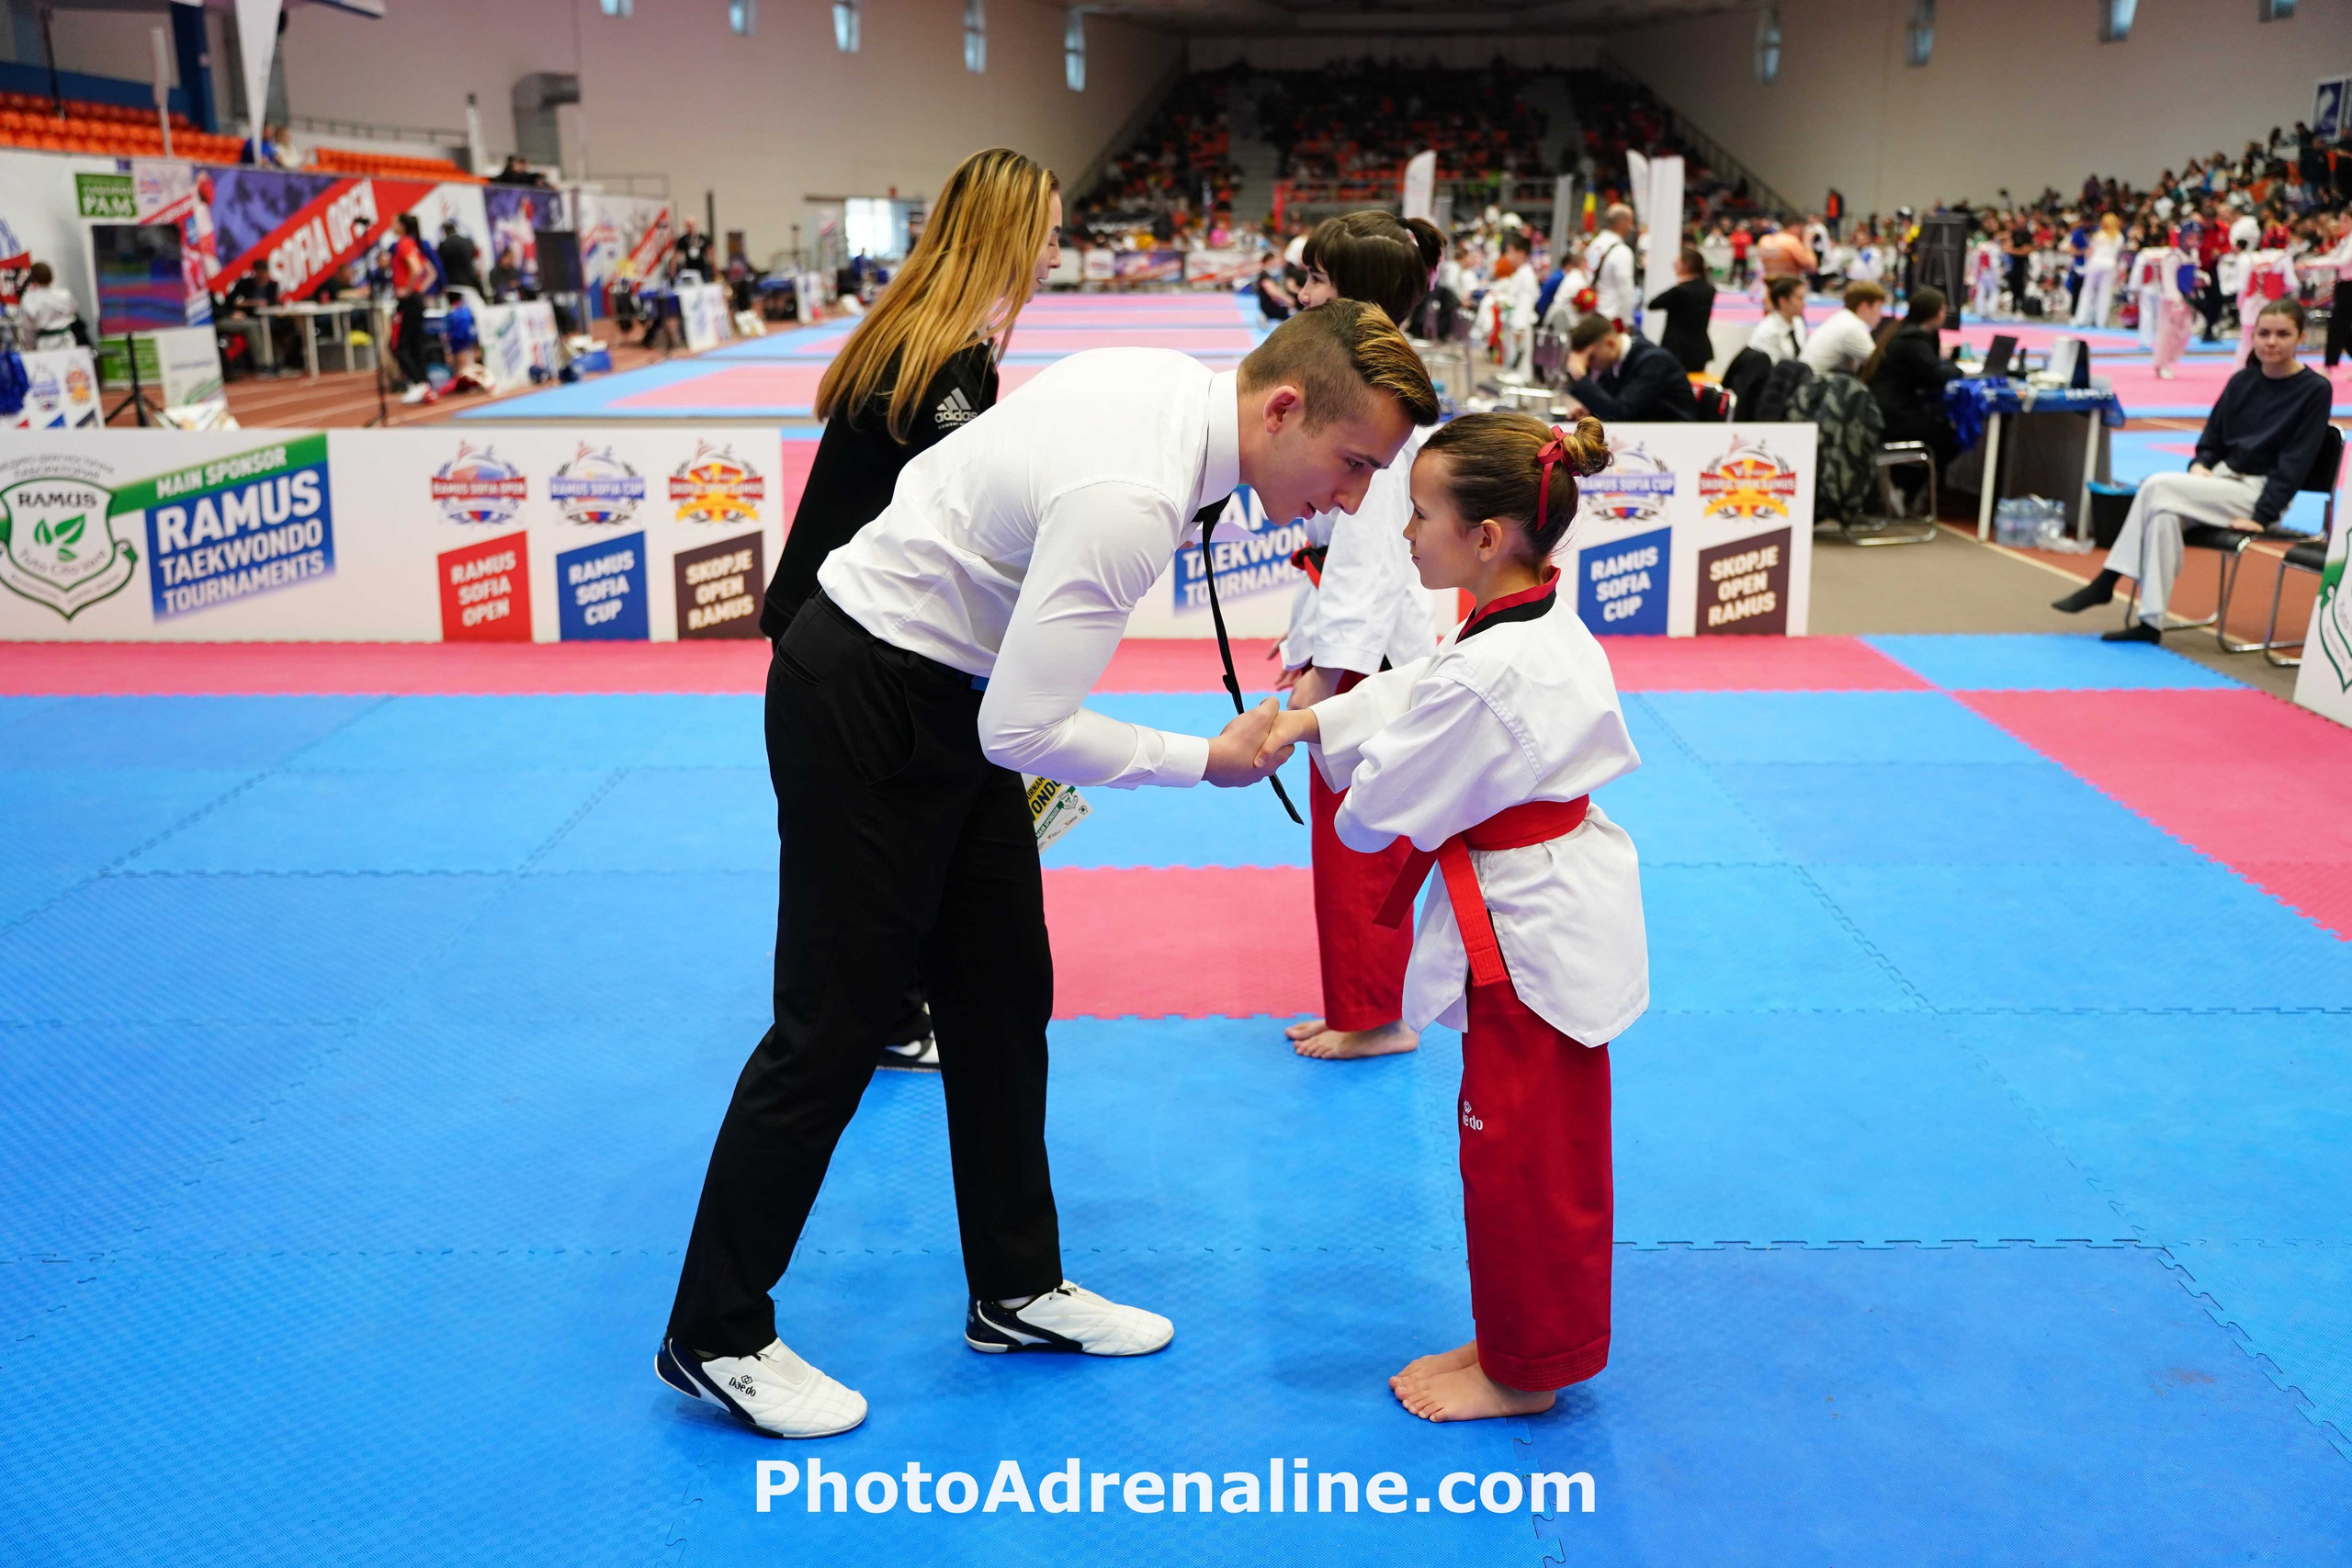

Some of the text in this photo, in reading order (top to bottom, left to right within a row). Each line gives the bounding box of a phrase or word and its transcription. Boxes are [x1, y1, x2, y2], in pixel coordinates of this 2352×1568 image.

[267, 215, 333, 293] SOFIA
[326, 175, 379, 254] OPEN
[934, 410, 978, 423] adidas
[156, 446, 288, 499] MAIN SPONSOR
[17, 491, 98, 509] RAMUS
[155, 469, 322, 555] RAMUS
[159, 517, 323, 588] TAEKWONDO
[450, 550, 516, 585] RAMUS
[569, 549, 636, 585] RAMUS
[684, 548, 753, 585] SKOPJE
[1182, 524, 1308, 581] TAEKWON
[1590, 546, 1659, 581] RAMUS
[1709, 545, 1780, 581] SKOPJE
[163, 549, 325, 615] TOURNAMENTS
[458, 575, 512, 606] SOFIA
[575, 574, 630, 606] SOFIA
[695, 573, 745, 606] OPEN
[1595, 571, 1651, 603] SOFIA
[1717, 570, 1769, 602] OPEN
[462, 598, 510, 626] OPEN
[583, 598, 624, 626] CUP
[687, 593, 754, 631] RAMUS
[1603, 595, 1644, 623] CUP
[1707, 591, 1777, 627] RAMUS
[729, 1376, 757, 1397] Daedo
